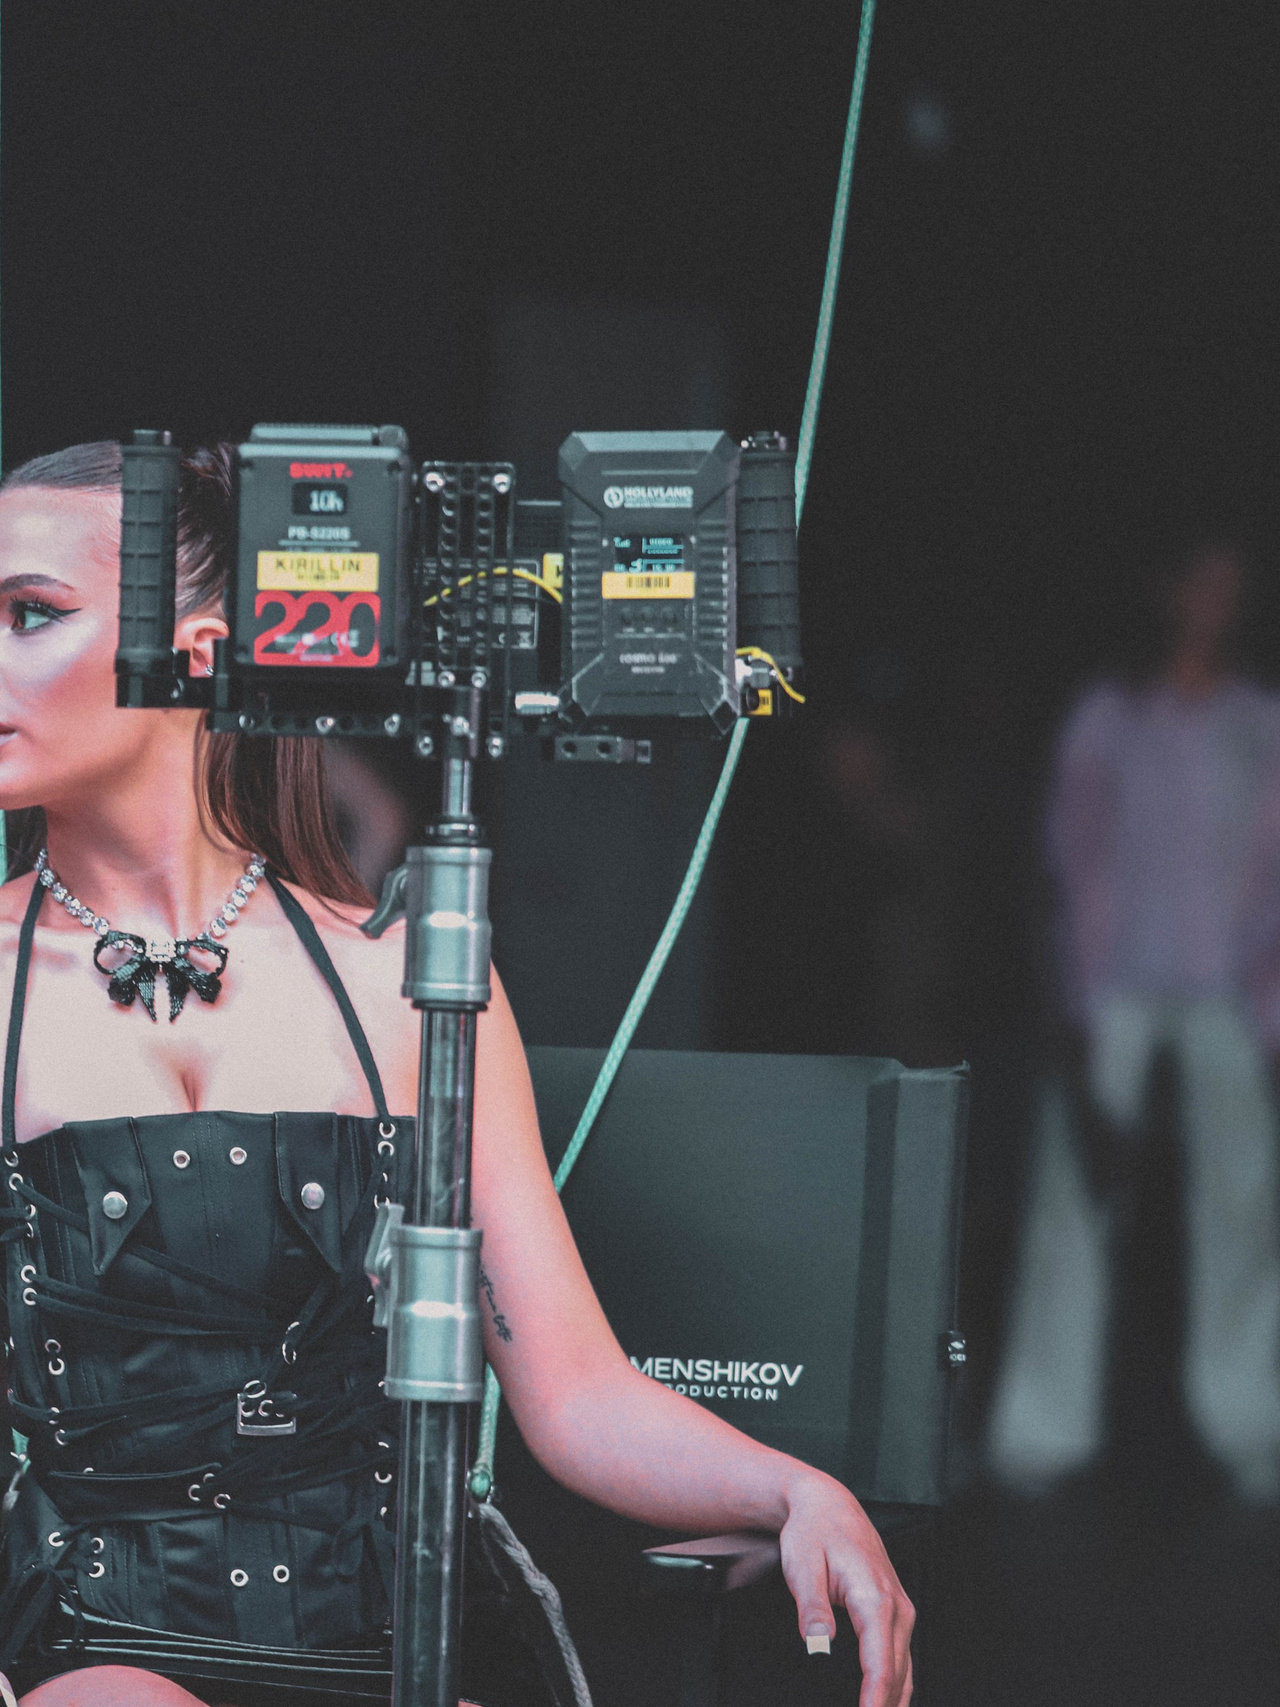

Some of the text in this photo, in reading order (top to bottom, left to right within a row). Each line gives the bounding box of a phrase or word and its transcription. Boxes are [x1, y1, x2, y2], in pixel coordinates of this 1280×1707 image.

[310, 490, 344, 511] 10h
[623, 486, 694, 499] HOLLYLAND
[275, 557, 360, 572] KIRILLIN
[254, 590, 381, 667] 220
[630, 1356, 804, 1387] MENSHIKOV
[664, 1383, 778, 1401] ODUCTION
